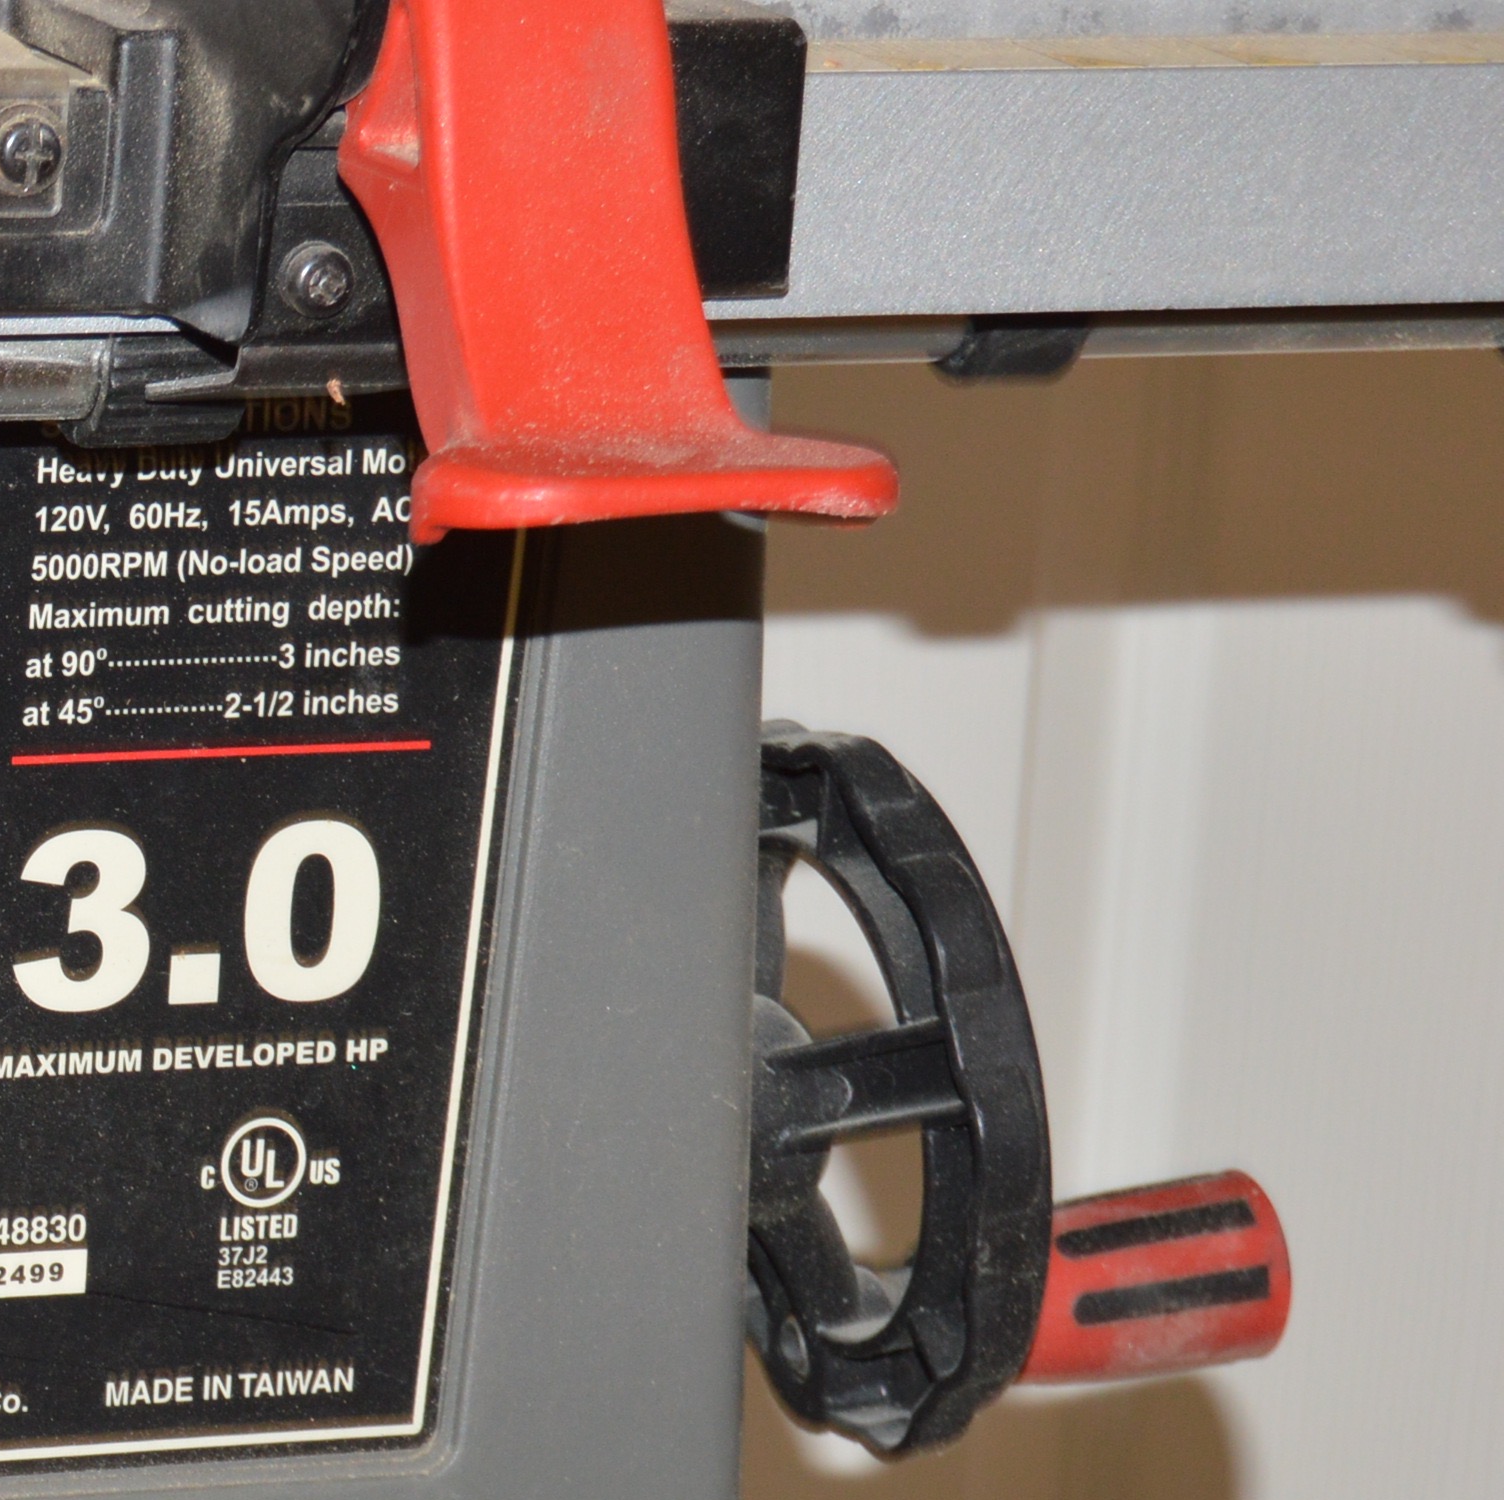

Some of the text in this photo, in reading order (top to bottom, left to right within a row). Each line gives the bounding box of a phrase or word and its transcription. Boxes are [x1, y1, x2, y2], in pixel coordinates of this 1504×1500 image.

[37, 455, 125, 488] Heavy
[136, 449, 203, 487] Duty
[215, 449, 353, 479] Universal
[35, 504, 110, 535] 120V,
[129, 502, 209, 531] 60Hz,
[228, 497, 355, 529] 15Amps,
[31, 543, 413, 583] 5000RPM (No-load Speed)
[29, 593, 400, 630] Maximum cutting depth:
[25, 654, 52, 679] at
[305, 642, 401, 667] inches
[22, 703, 50, 727] at
[303, 690, 398, 714] inches
[12, 820, 380, 1013] 3.0
[152, 1040, 335, 1071] DEVELOPED
[346, 1038, 388, 1062] HP
[309, 1158, 341, 1185] US
[220, 1214, 298, 1242] LISTED
[218, 1245, 268, 1266] 37J2
[217, 1267, 294, 1289] E82443
[104, 1367, 355, 1408] MADE IN TAIWAN
